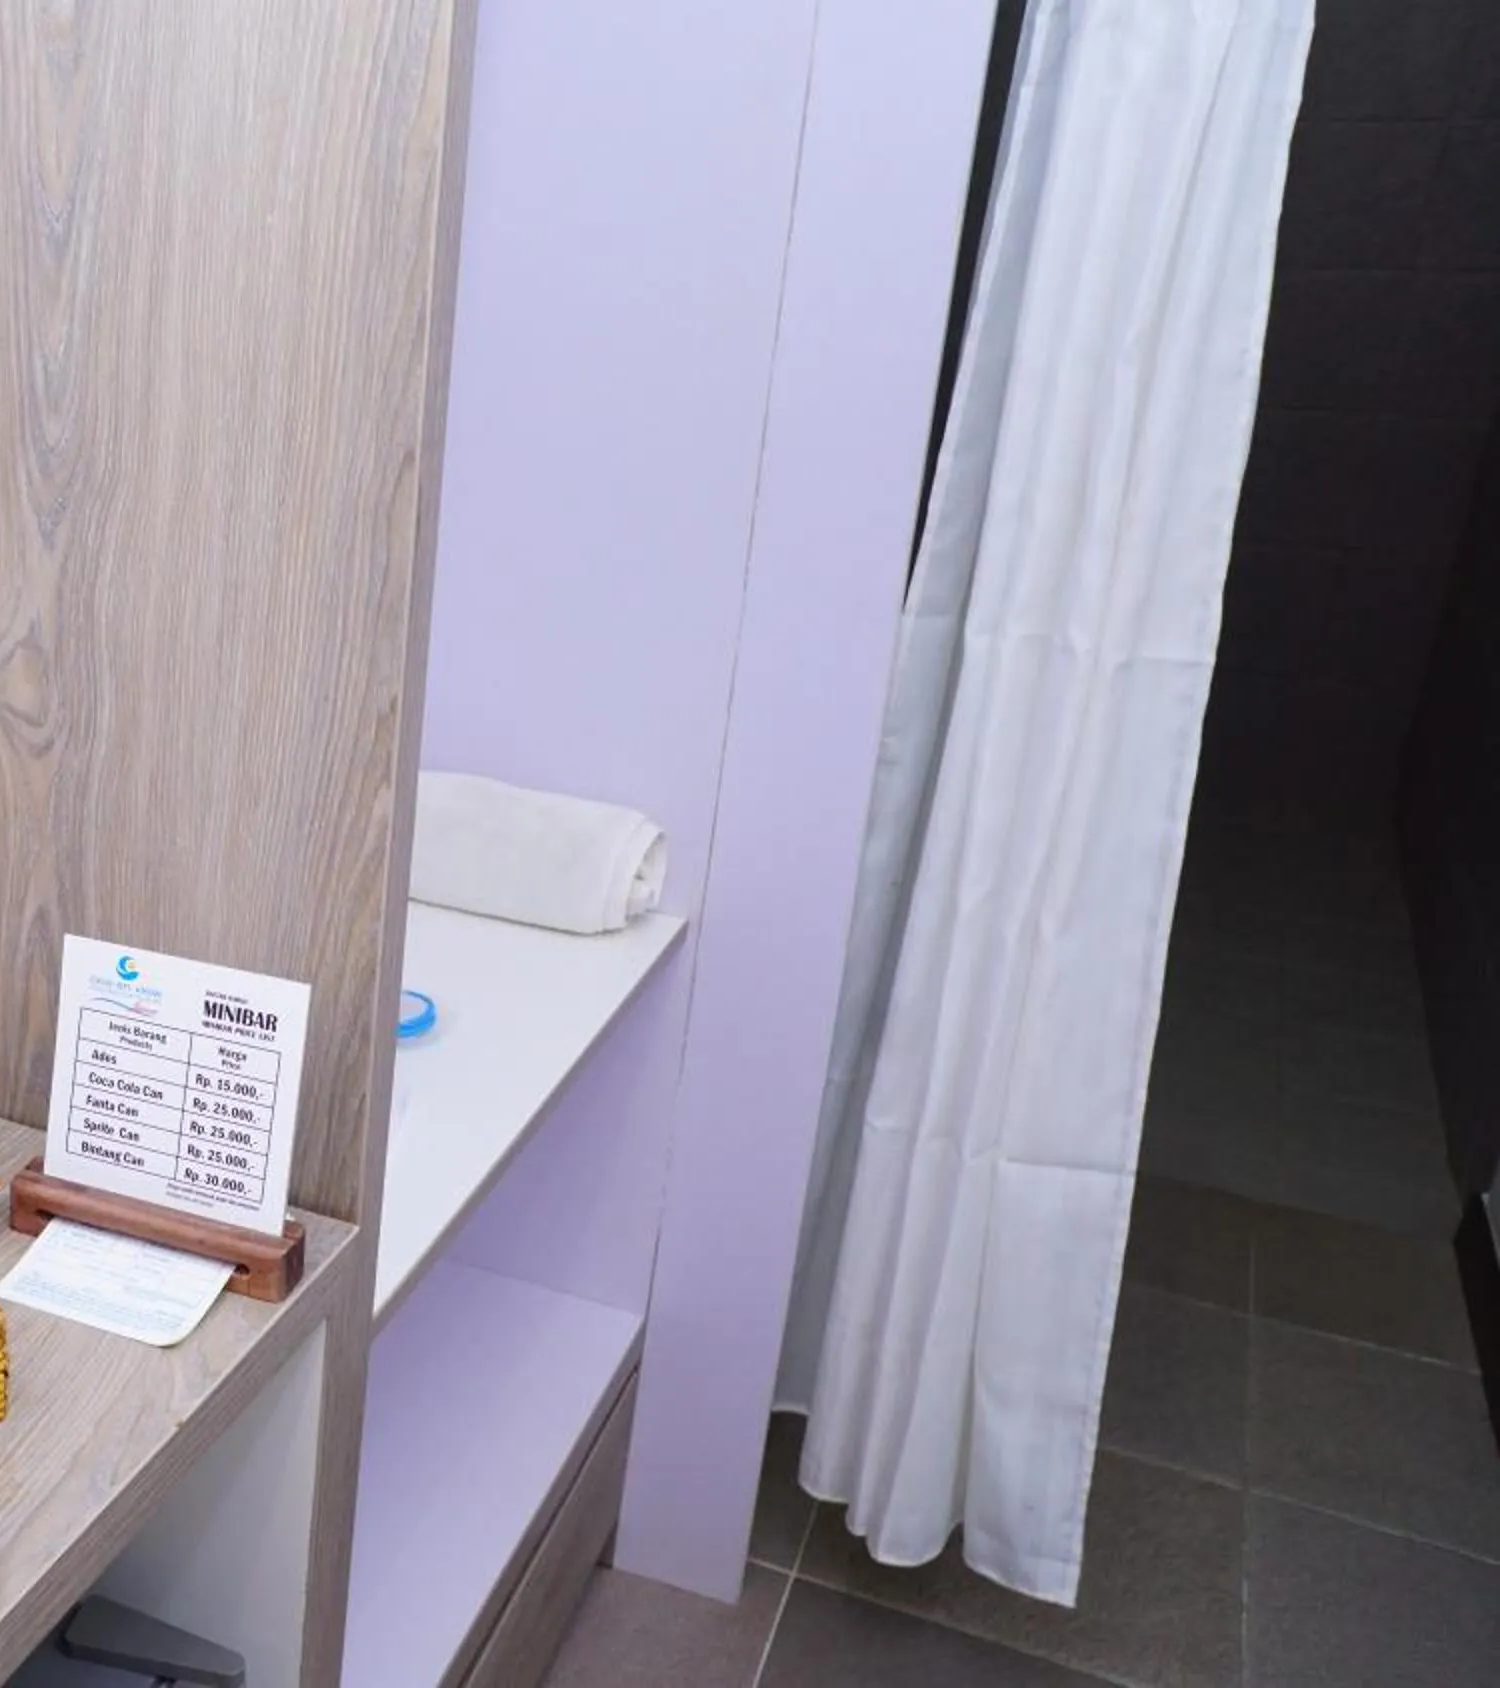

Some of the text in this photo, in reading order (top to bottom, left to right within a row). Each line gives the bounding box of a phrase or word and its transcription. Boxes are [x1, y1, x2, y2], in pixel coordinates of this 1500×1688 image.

[204, 1000, 278, 1032] MINIBAR
[89, 1071, 163, 1100] Coca Cola Can
[195, 1073, 213, 1089] Rp.
[86, 1095, 139, 1117] Fanta Can
[192, 1097, 210, 1113] Rp.
[83, 1117, 140, 1141] Sprite Can
[190, 1121, 207, 1135] Rp.
[81, 1141, 145, 1166] Bintang Can
[187, 1144, 205, 1159] Rp.
[183, 1168, 200, 1182] Rp.
